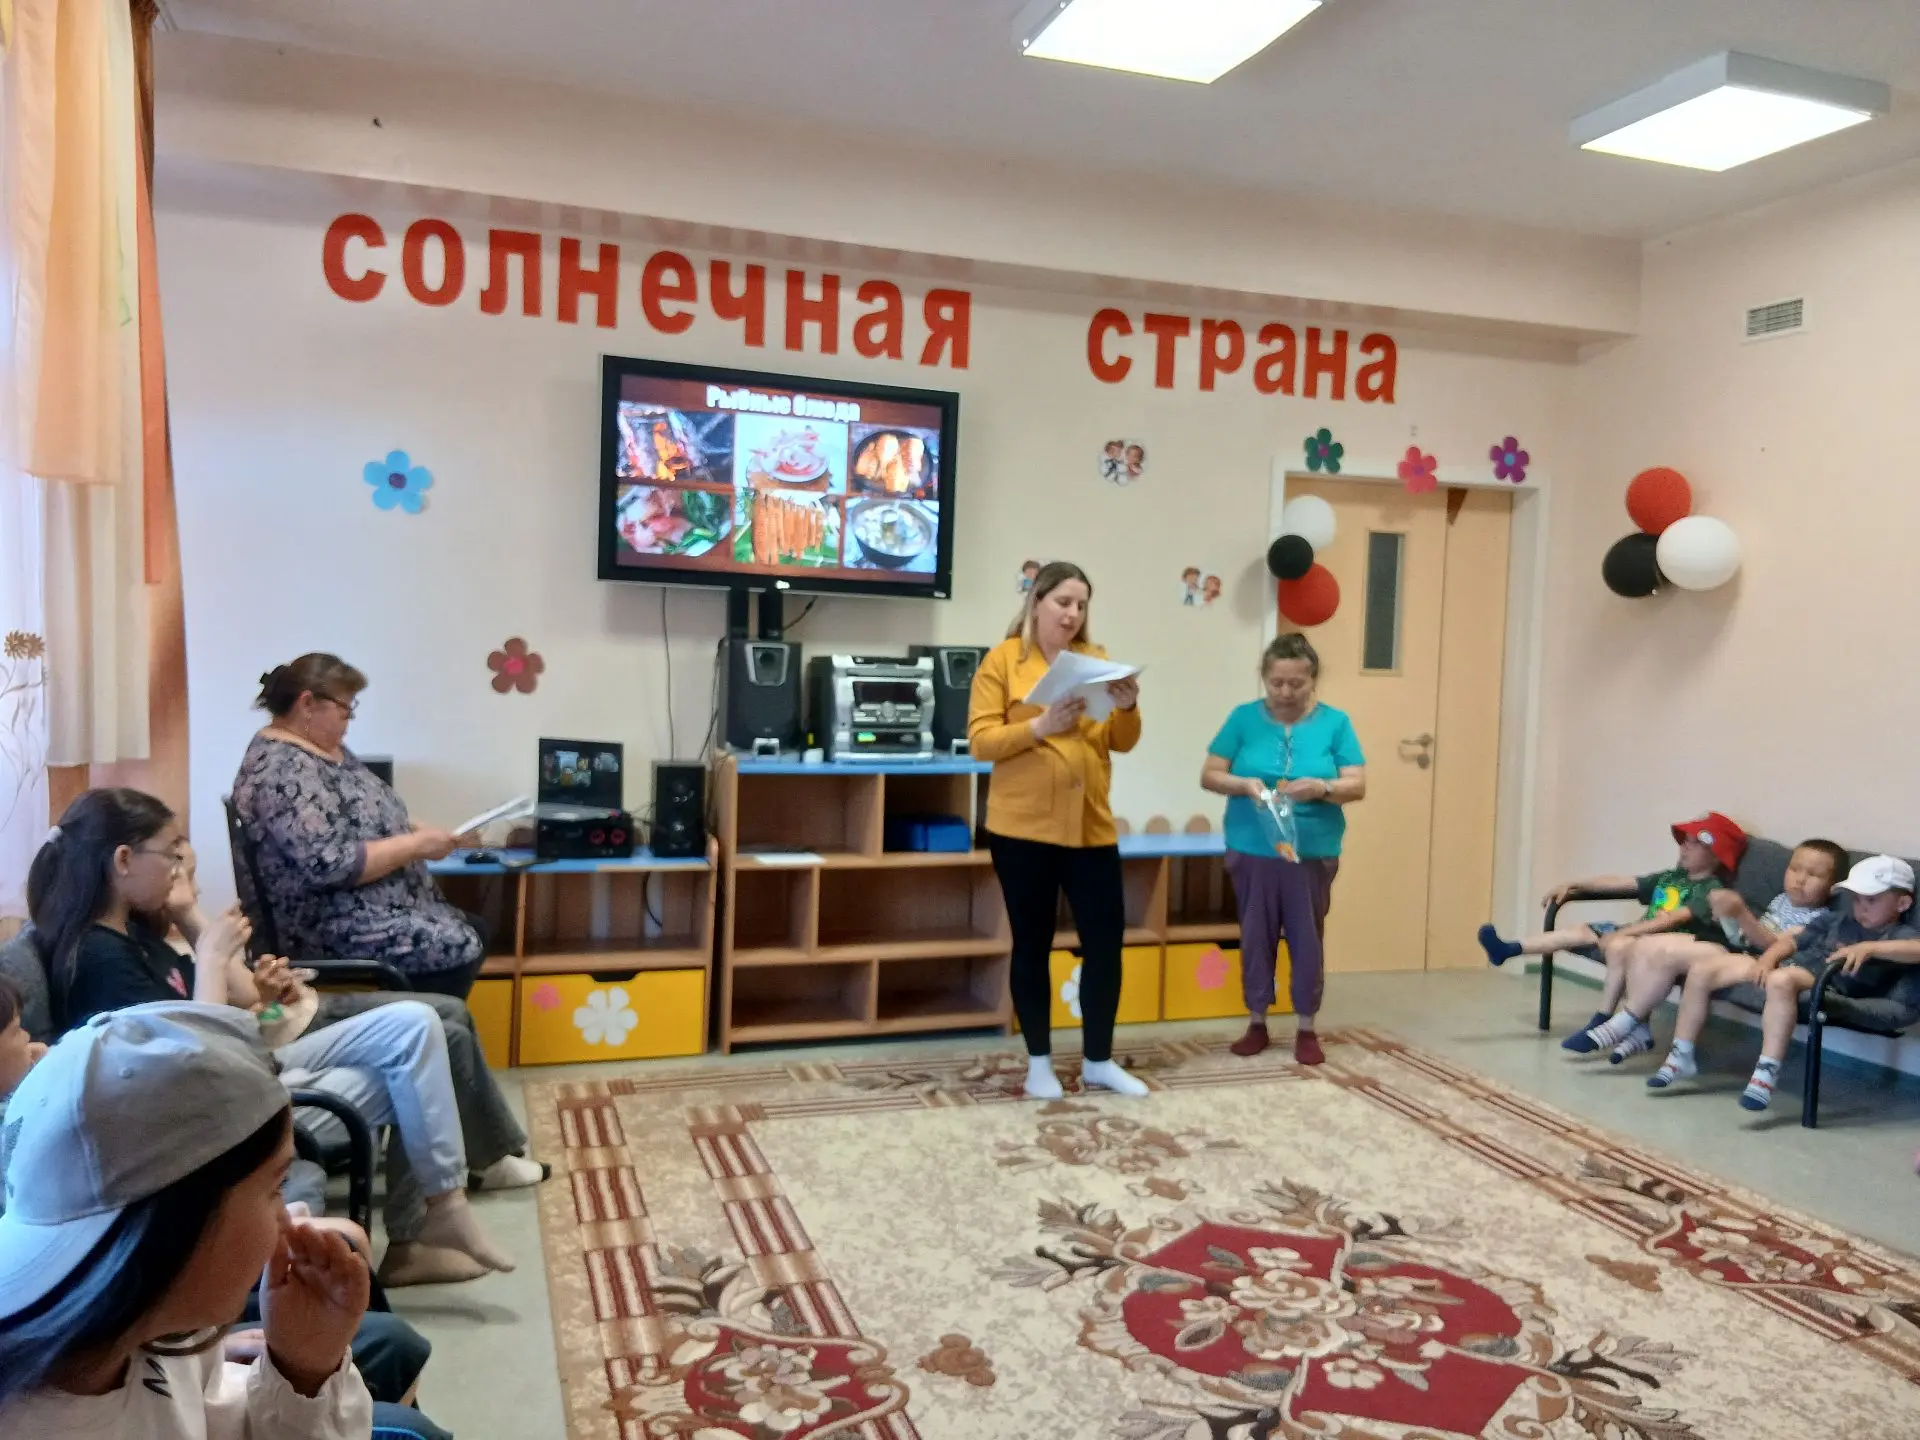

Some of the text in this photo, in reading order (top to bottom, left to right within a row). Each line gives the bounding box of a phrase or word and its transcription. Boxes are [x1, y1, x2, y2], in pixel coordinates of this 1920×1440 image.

[322, 213, 1398, 403] солнечная страна
[706, 385, 791, 414] Рыбные
